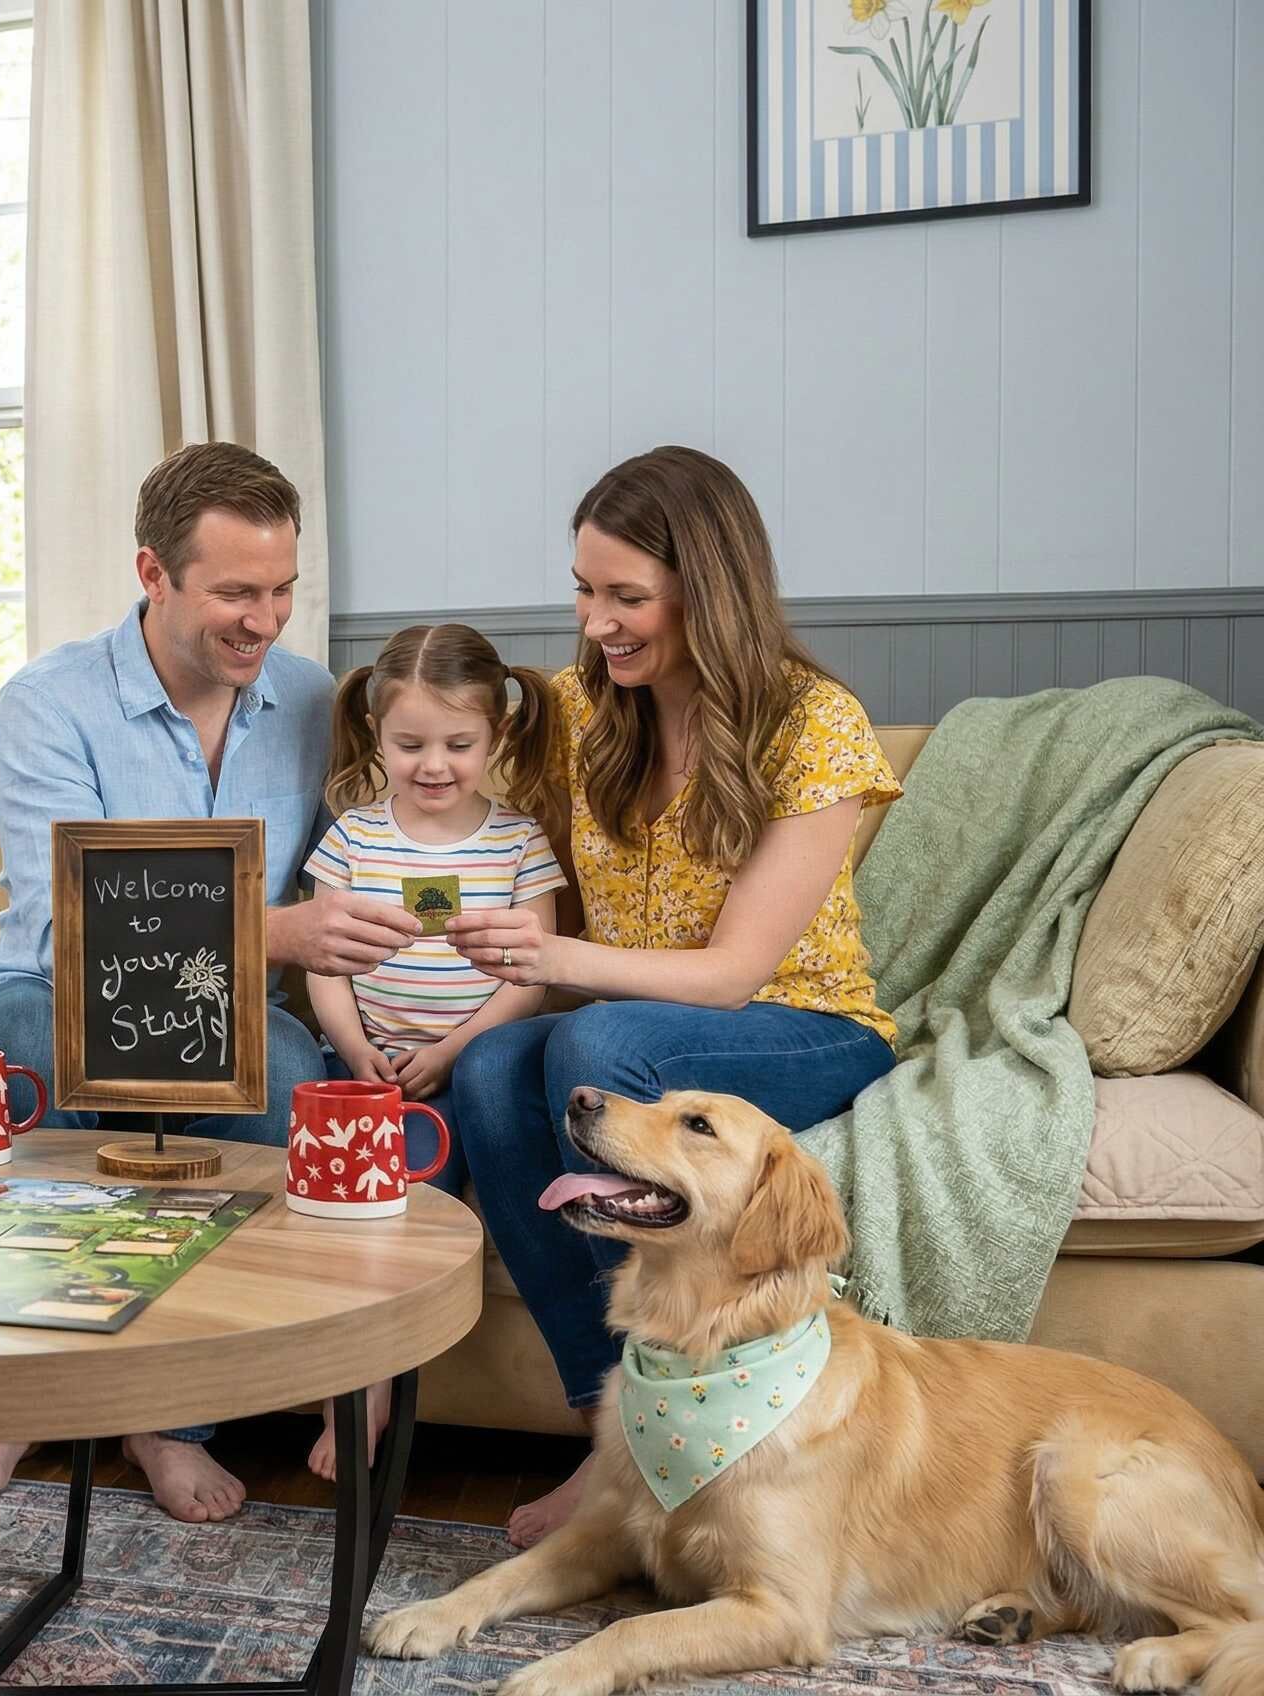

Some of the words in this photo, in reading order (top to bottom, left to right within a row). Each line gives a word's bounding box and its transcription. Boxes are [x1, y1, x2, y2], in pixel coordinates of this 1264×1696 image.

[93, 868, 227, 904] Welcome
[128, 915, 162, 933] to
[100, 951, 182, 1001] your
[110, 1003, 207, 1064] Stay
